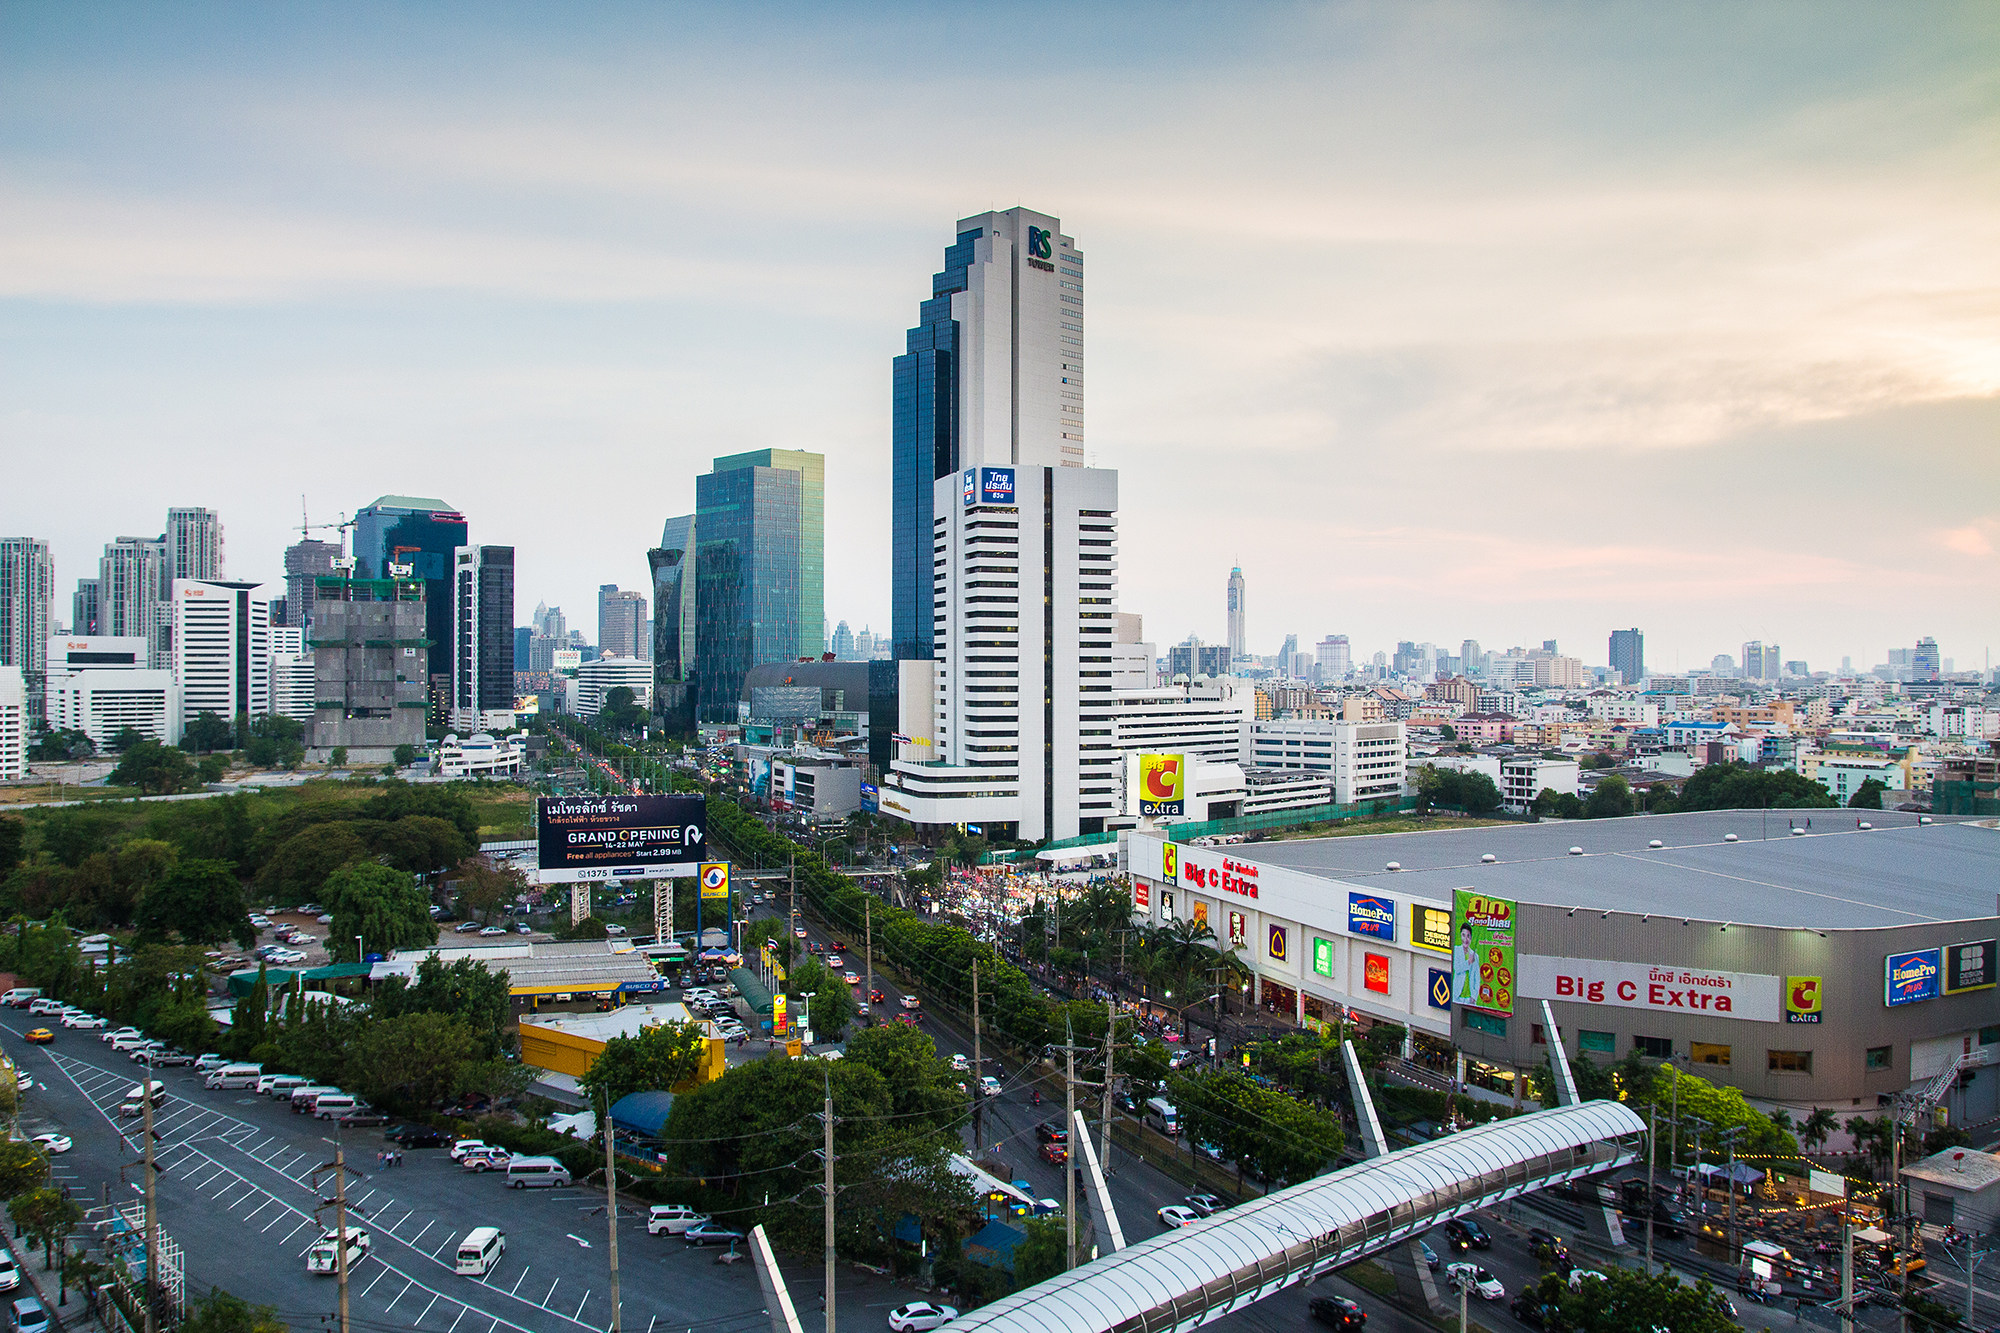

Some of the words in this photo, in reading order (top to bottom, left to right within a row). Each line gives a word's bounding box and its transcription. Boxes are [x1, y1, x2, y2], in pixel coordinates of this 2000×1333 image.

[1029, 225, 1052, 259] RS
[1027, 257, 1055, 272] TOWER
[1146, 760, 1165, 773] Big
[1147, 760, 1179, 799] C
[547, 799, 607, 815] เมโทรลักซ์
[611, 801, 638, 812] รัชดา
[568, 832, 617, 843] GRAND
[619, 829, 680, 841] OPENING
[587, 870, 607, 878] 1375
[1185, 862, 1205, 888] Big
[1208, 868, 1218, 888] C
[1222, 871, 1259, 899] Extra
[1350, 903, 1393, 922] HomePro
[1468, 896, 1506, 918] ถูก
[1360, 922, 1379, 931] PLUS
[1424, 931, 1450, 941] DESIGN
[1424, 936, 1450, 948] SQUARE
[1649, 967, 1674, 983] บิ๊กซี
[1893, 965, 1936, 980] HomePro
[1556, 975, 1605, 1002] Big
[1617, 980, 1637, 1001] C
[1648, 983, 1733, 1012] Extra
[1792, 981, 1818, 1010] C
[1903, 981, 1923, 996] PLUS
